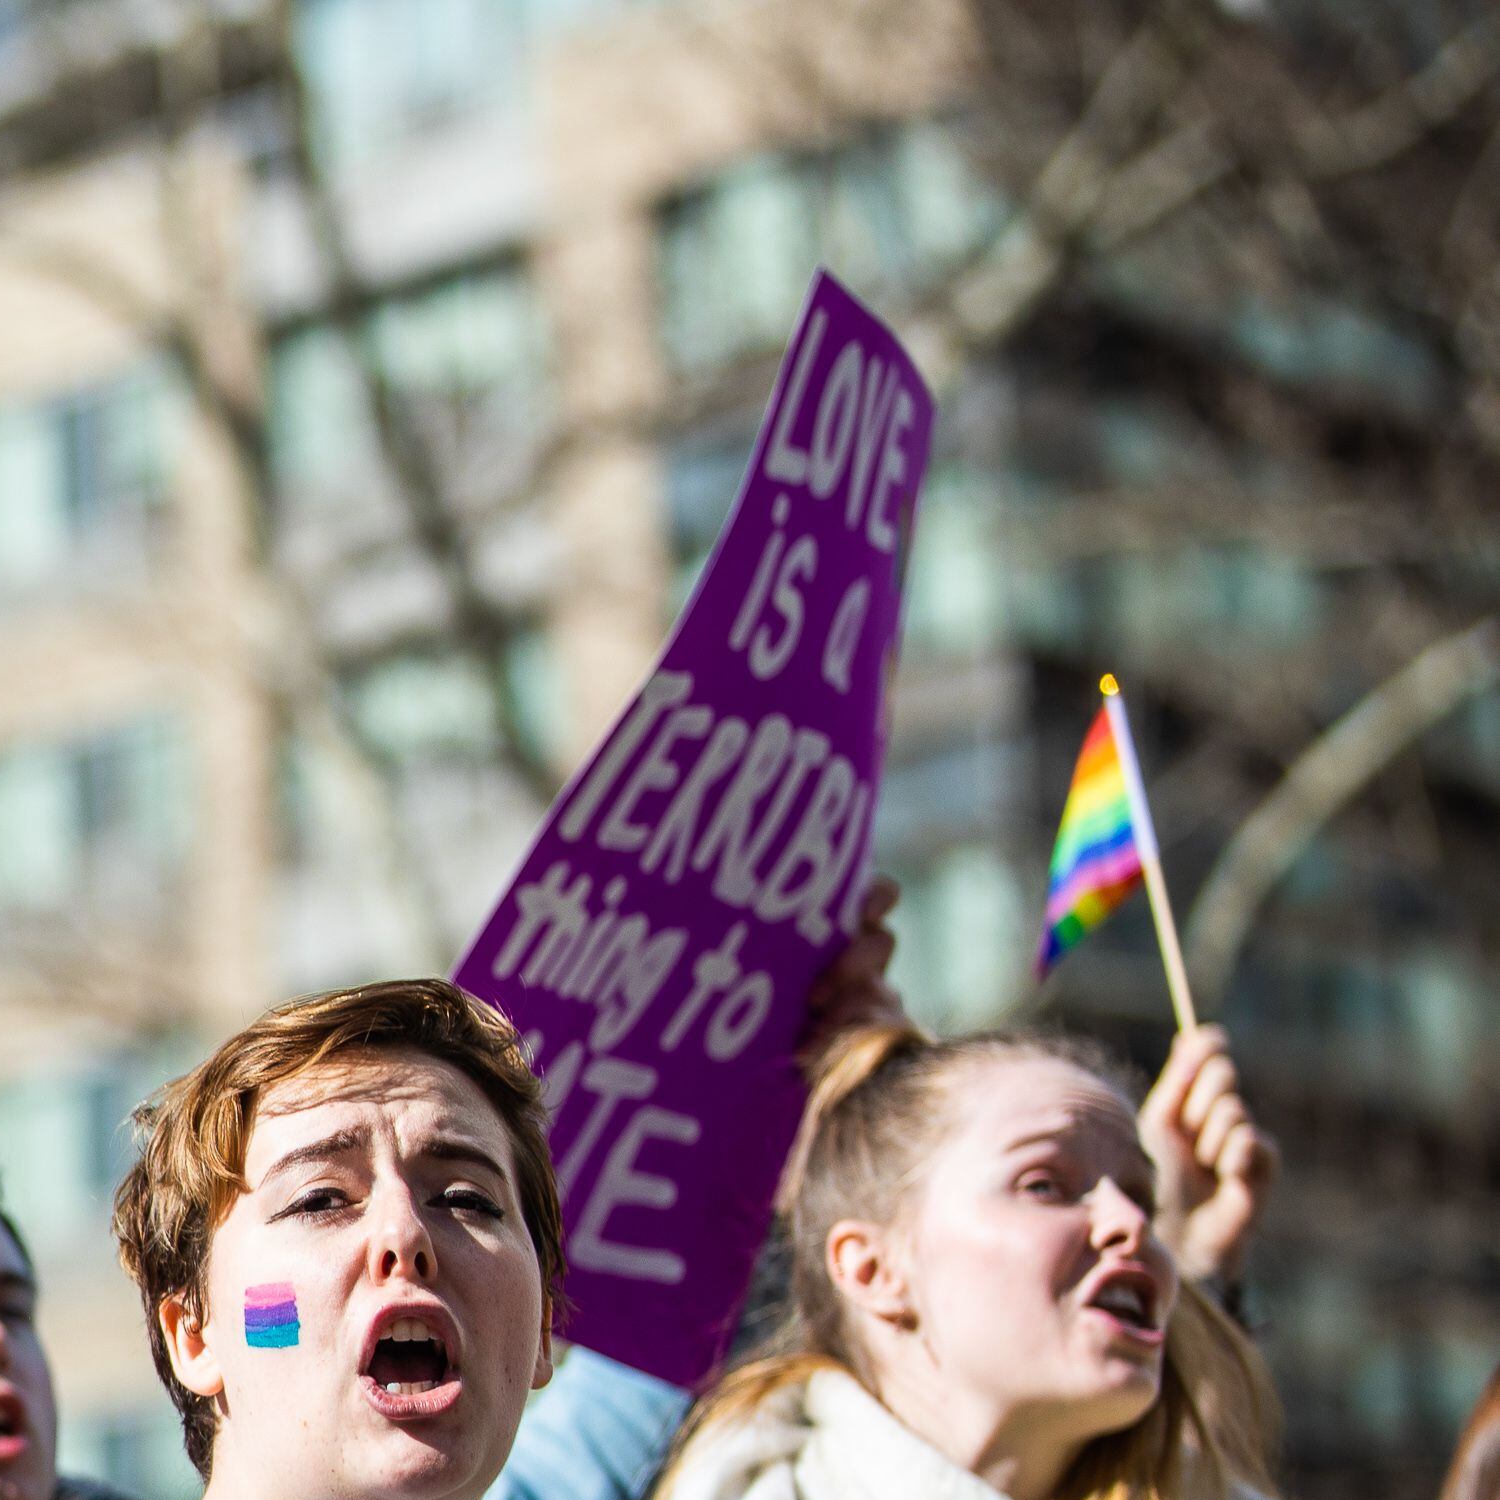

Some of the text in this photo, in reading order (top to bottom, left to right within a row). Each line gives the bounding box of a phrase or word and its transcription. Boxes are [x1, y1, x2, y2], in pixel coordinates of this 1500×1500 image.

[766, 308, 913, 553] LOVE
[558, 670, 874, 946] TERRIBL
[492, 860, 775, 1062] thing to
[521, 1028, 702, 1286] TE
